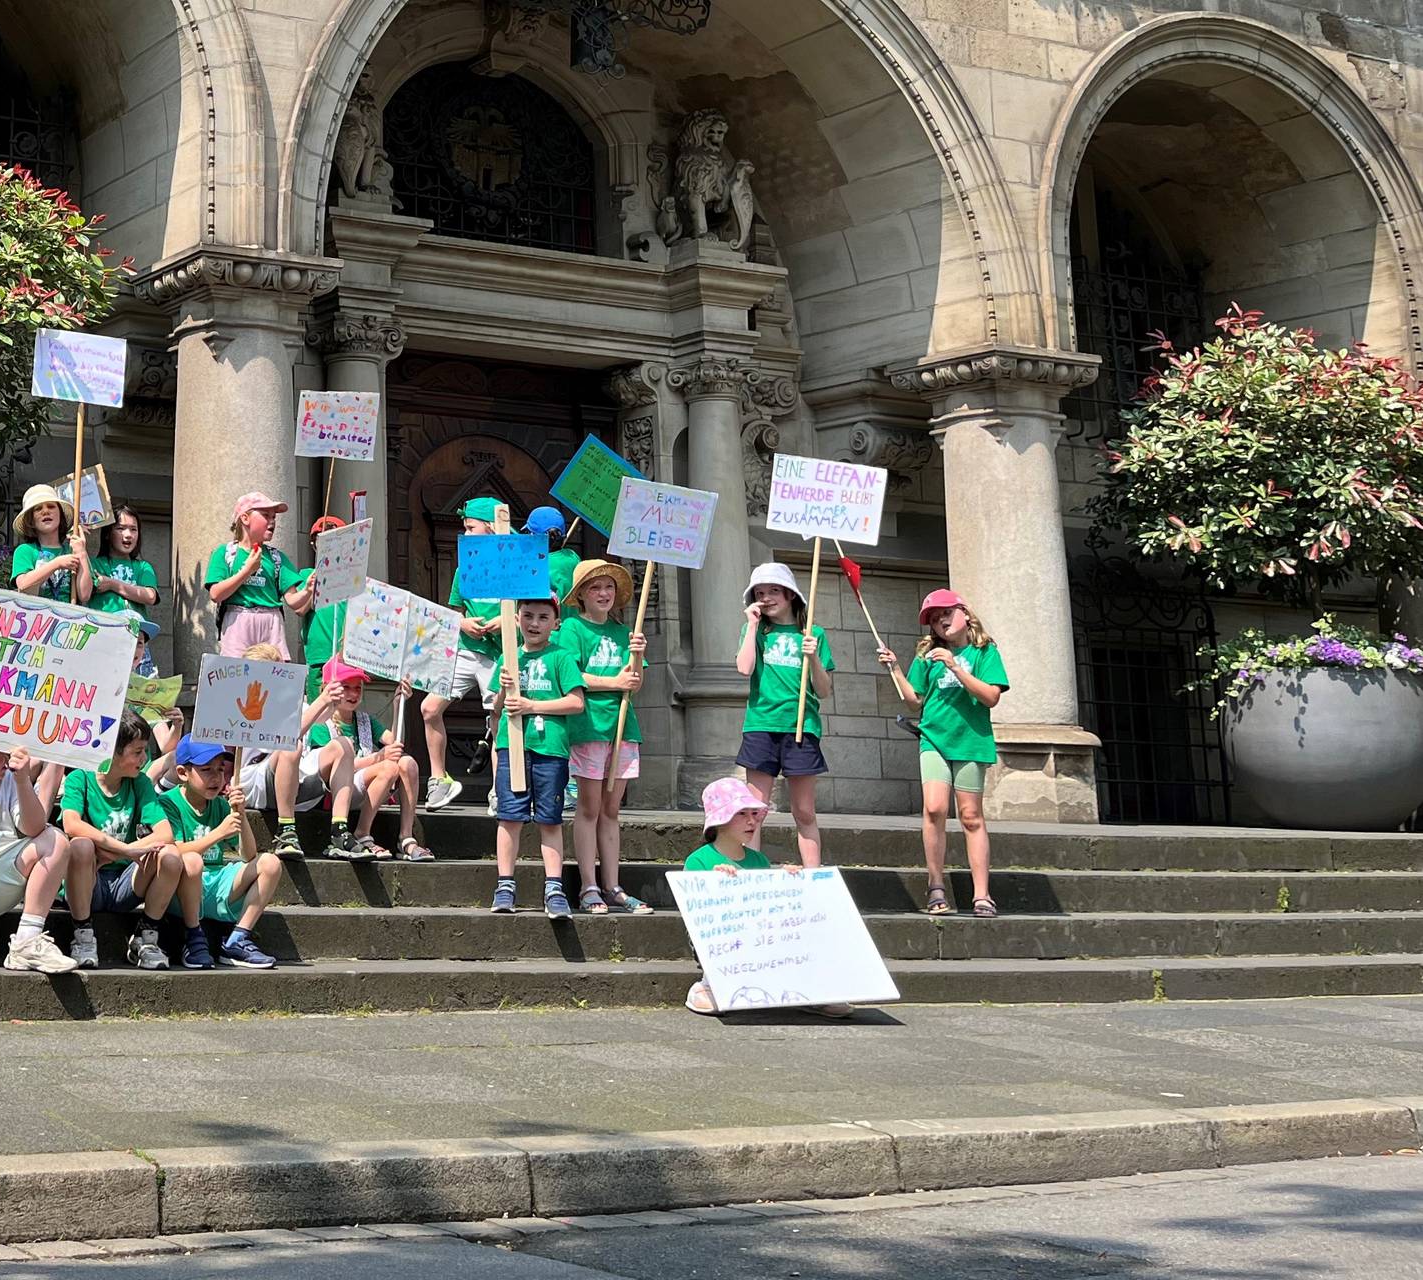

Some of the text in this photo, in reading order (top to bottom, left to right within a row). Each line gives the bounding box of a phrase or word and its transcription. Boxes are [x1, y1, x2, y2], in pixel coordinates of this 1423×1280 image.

[776, 455, 883, 489] EINE ELEFAN-
[772, 481, 834, 503] TENHERDE
[805, 503, 848, 516] IMMER
[27, 613, 99, 651] NICHT
[207, 664, 296, 687] FINGER WEG
[37, 711, 117, 750] UNS!
[227, 718, 256, 729] VON
